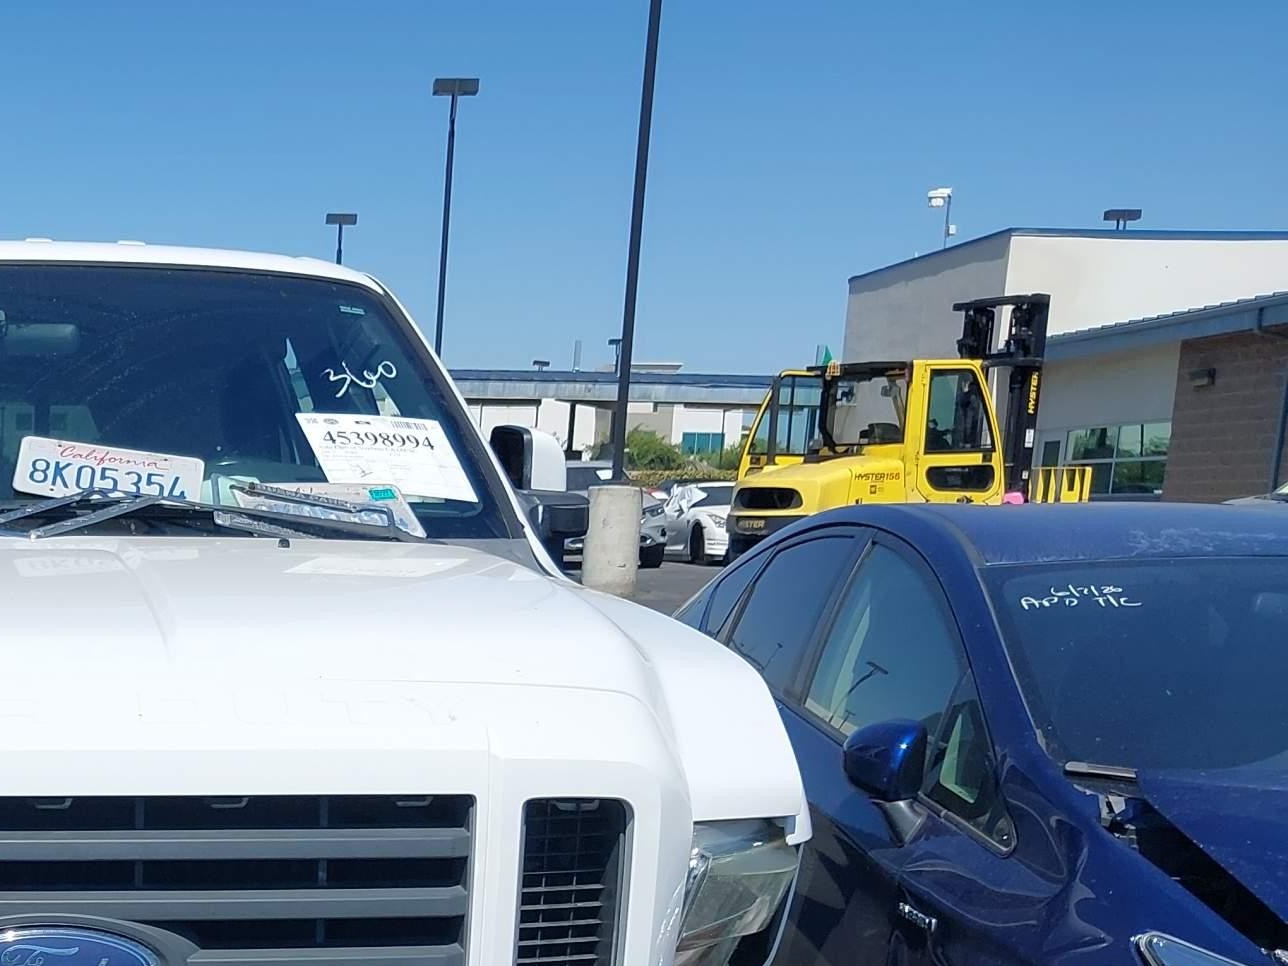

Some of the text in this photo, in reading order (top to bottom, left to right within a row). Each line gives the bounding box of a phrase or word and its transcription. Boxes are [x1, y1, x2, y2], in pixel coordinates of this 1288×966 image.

[1027, 371, 1040, 414] HYSTER
[323, 431, 434, 451] 45398994
[59, 446, 169, 470] California
[738, 519, 766, 528] STER
